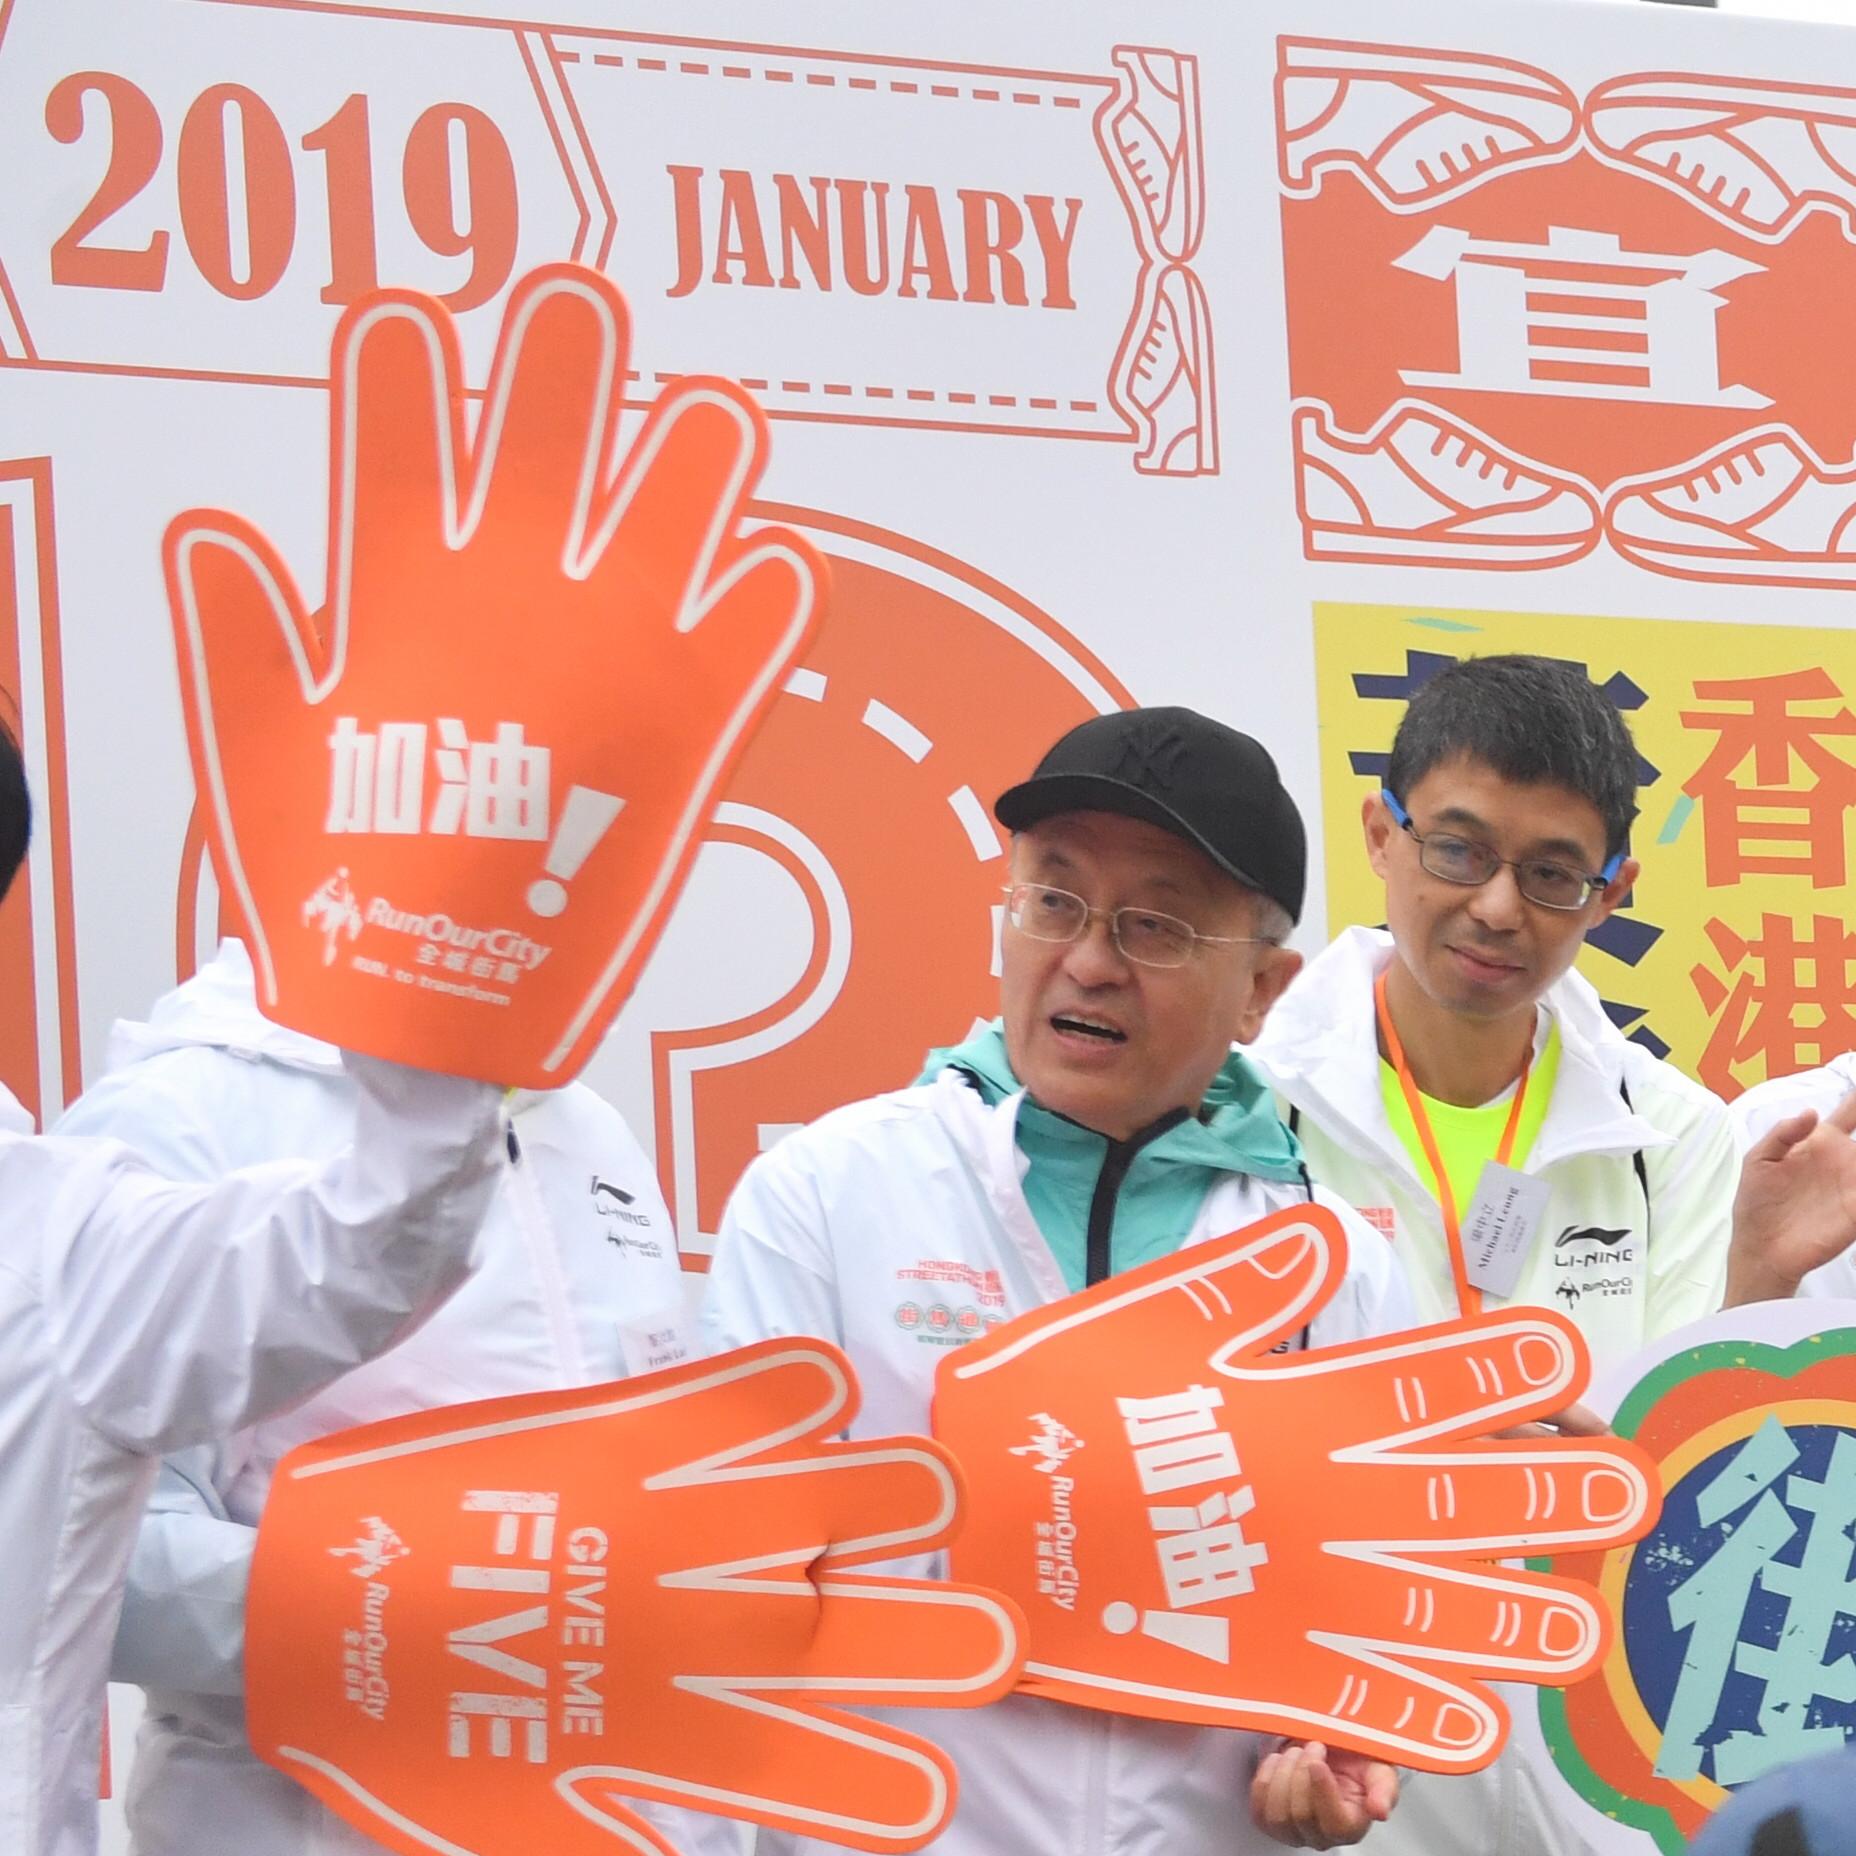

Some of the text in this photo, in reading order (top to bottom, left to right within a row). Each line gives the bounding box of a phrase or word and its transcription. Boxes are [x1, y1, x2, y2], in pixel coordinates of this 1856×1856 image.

[44, 70, 520, 315] 2019
[666, 162, 1083, 311] JANUARY
[1392, 225, 1777, 410] 宜
[367, 896, 552, 970] RunOurCity
[447, 1489, 559, 1763] FIVE
[1050, 1475, 1080, 1611] RunOurCity
[360, 1581, 390, 1721] RunOurCity
[561, 1526, 608, 1735] GIVE ME
